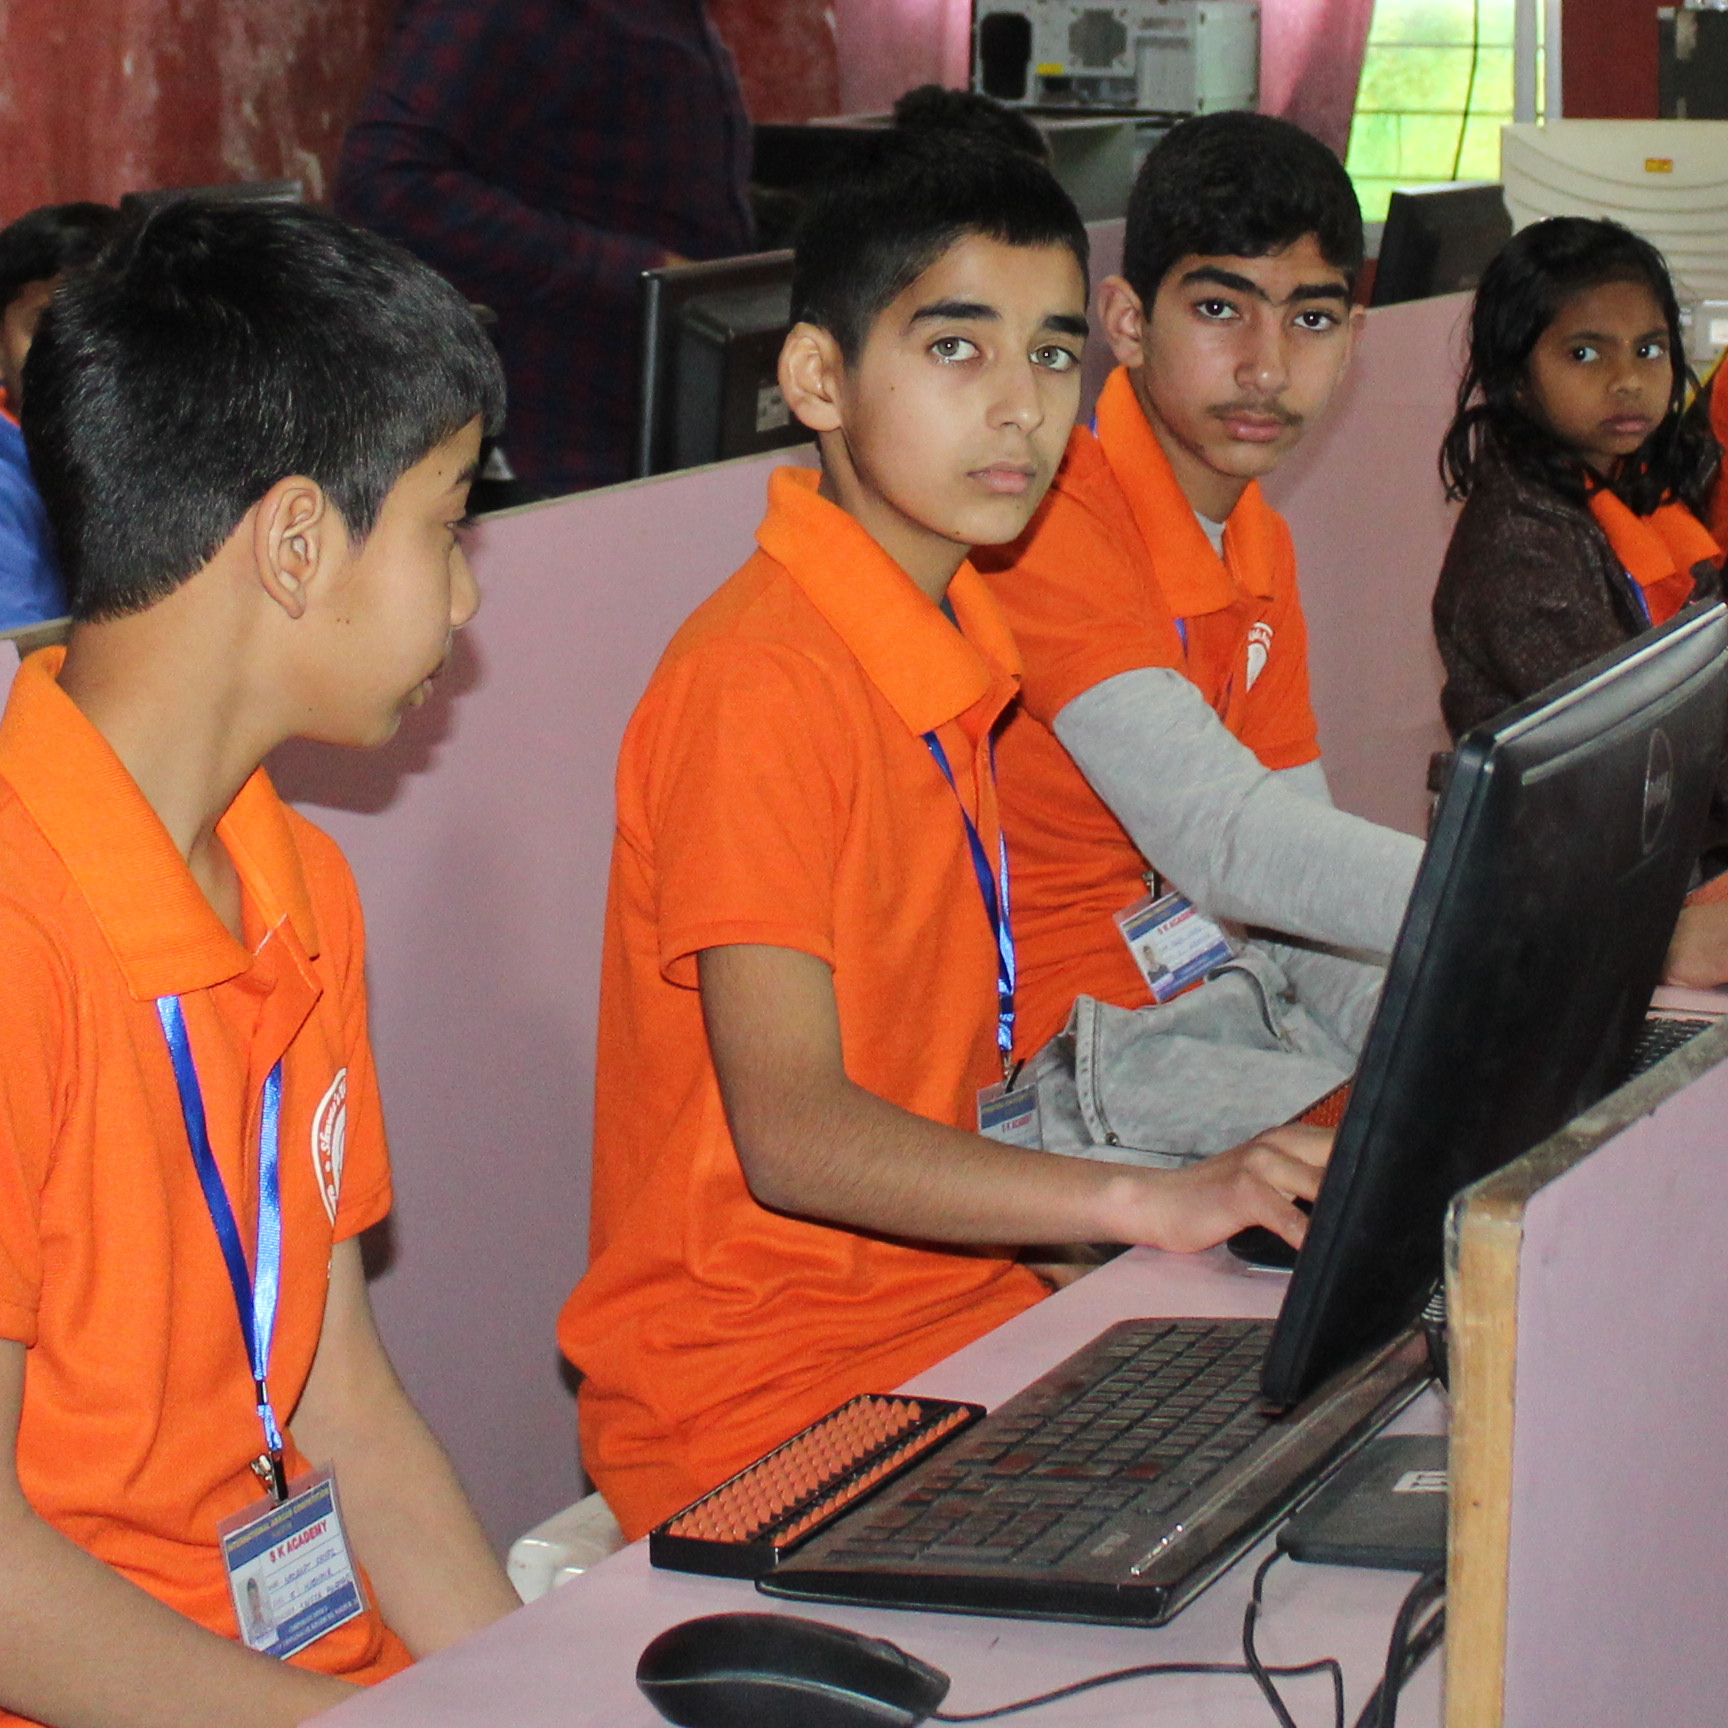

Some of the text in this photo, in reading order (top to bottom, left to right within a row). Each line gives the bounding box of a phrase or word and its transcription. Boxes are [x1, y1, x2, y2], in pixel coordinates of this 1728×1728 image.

[269, 1519, 327, 1563] S K ACADEMY
